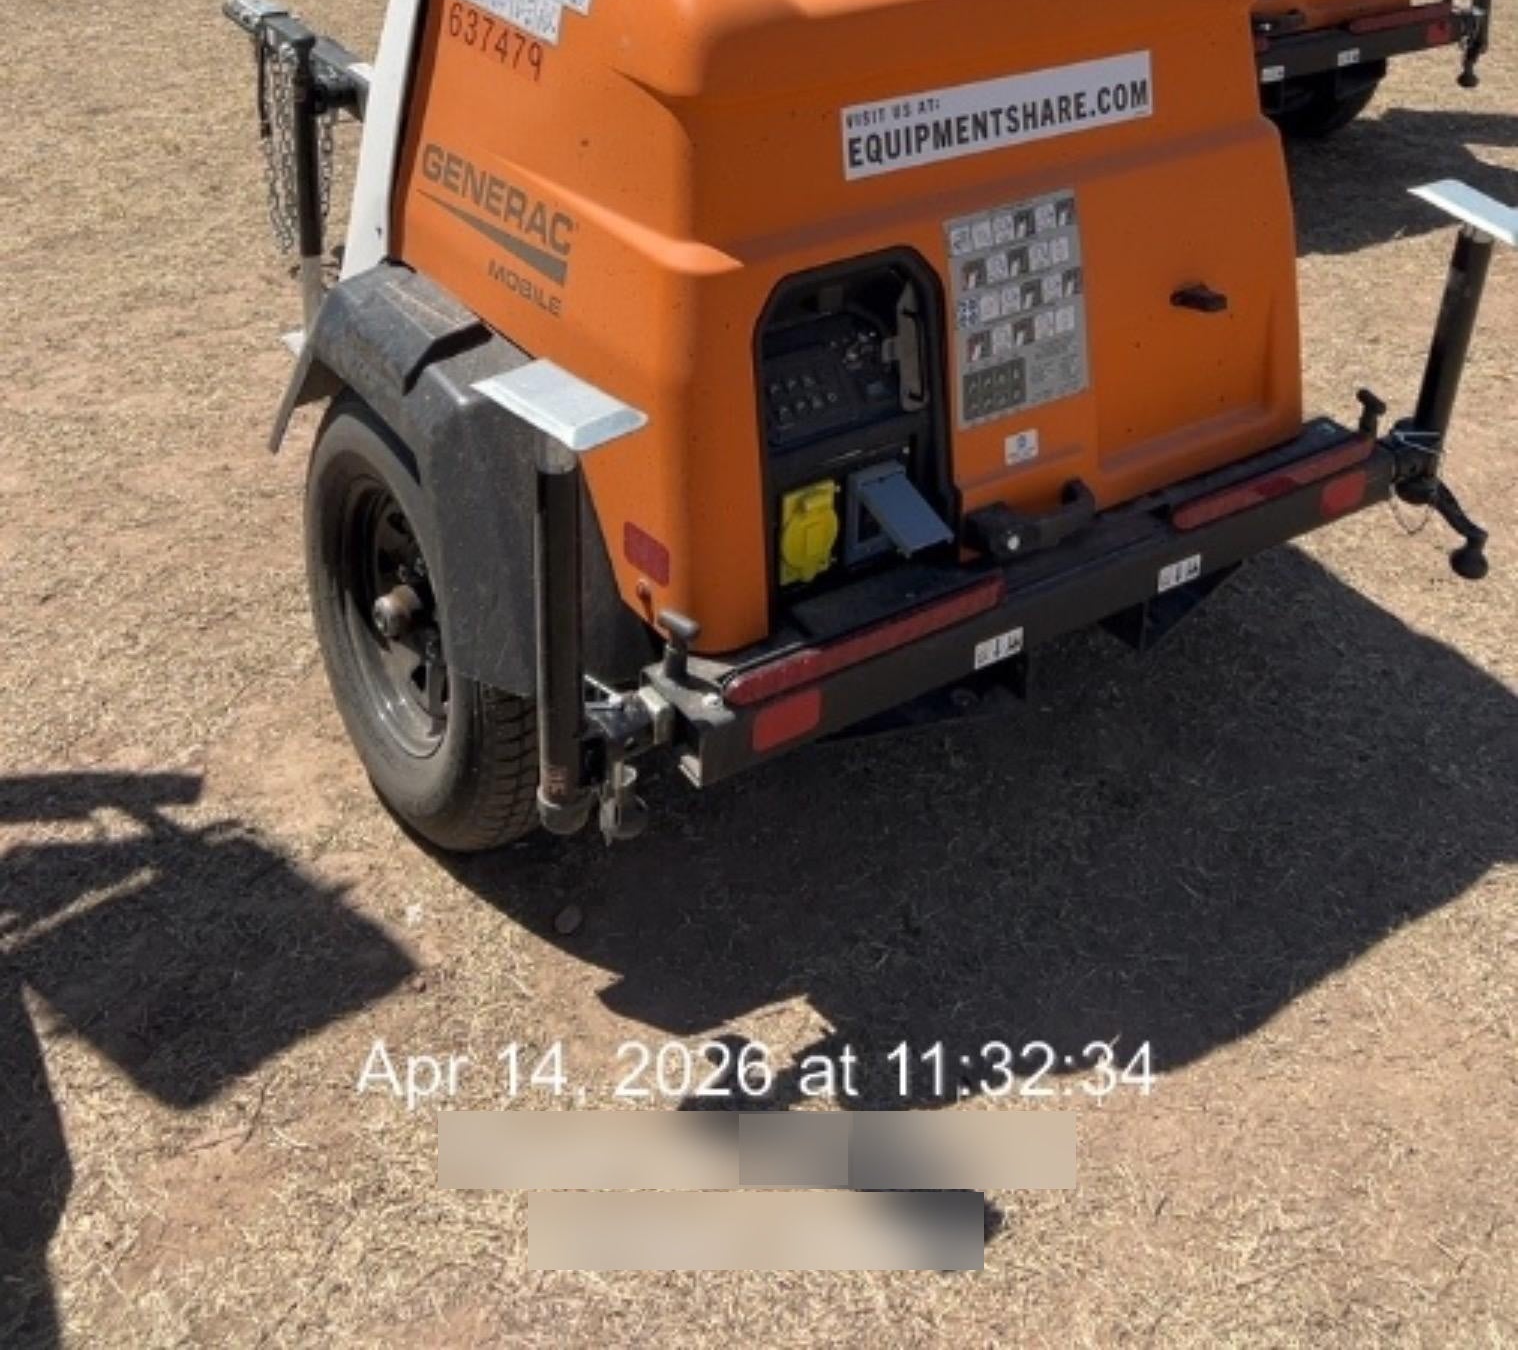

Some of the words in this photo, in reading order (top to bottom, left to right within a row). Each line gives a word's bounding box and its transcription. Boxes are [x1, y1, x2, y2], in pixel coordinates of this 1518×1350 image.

[449, 3, 543, 81] 637479
[848, 79, 1149, 167] EQUIPMENTSHARE.COM
[422, 143, 574, 257] GENERAC
[487, 259, 562, 318] MOBILE
